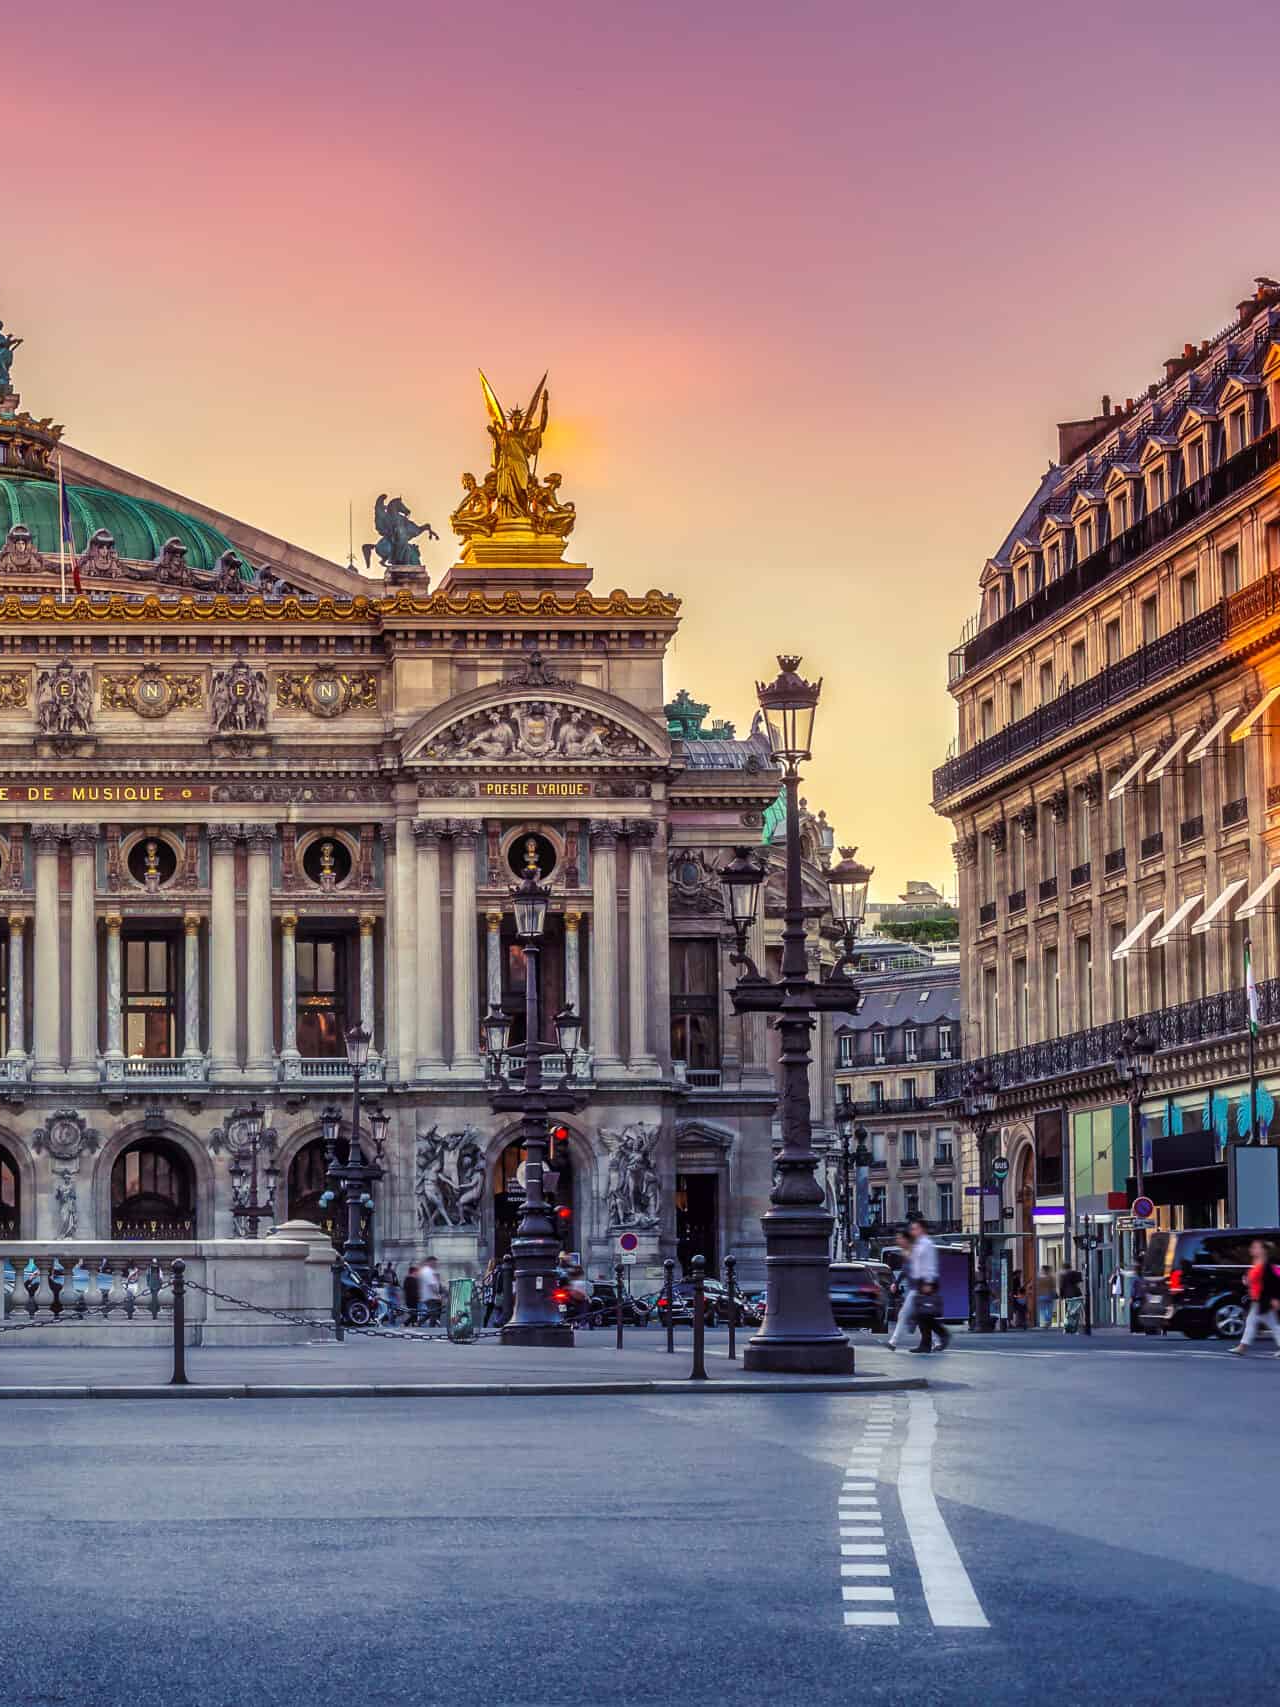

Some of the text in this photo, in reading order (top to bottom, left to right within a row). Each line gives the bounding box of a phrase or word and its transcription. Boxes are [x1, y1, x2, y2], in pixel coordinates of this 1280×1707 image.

[60, 686, 69, 696] E
[147, 686, 157, 697] N
[236, 685, 245, 695] E
[321, 685, 332, 697] N
[27, 787, 55, 801] DE
[72, 787, 165, 801] MUSIQUE
[487, 783, 585, 796] POESIE LYRIQUE
